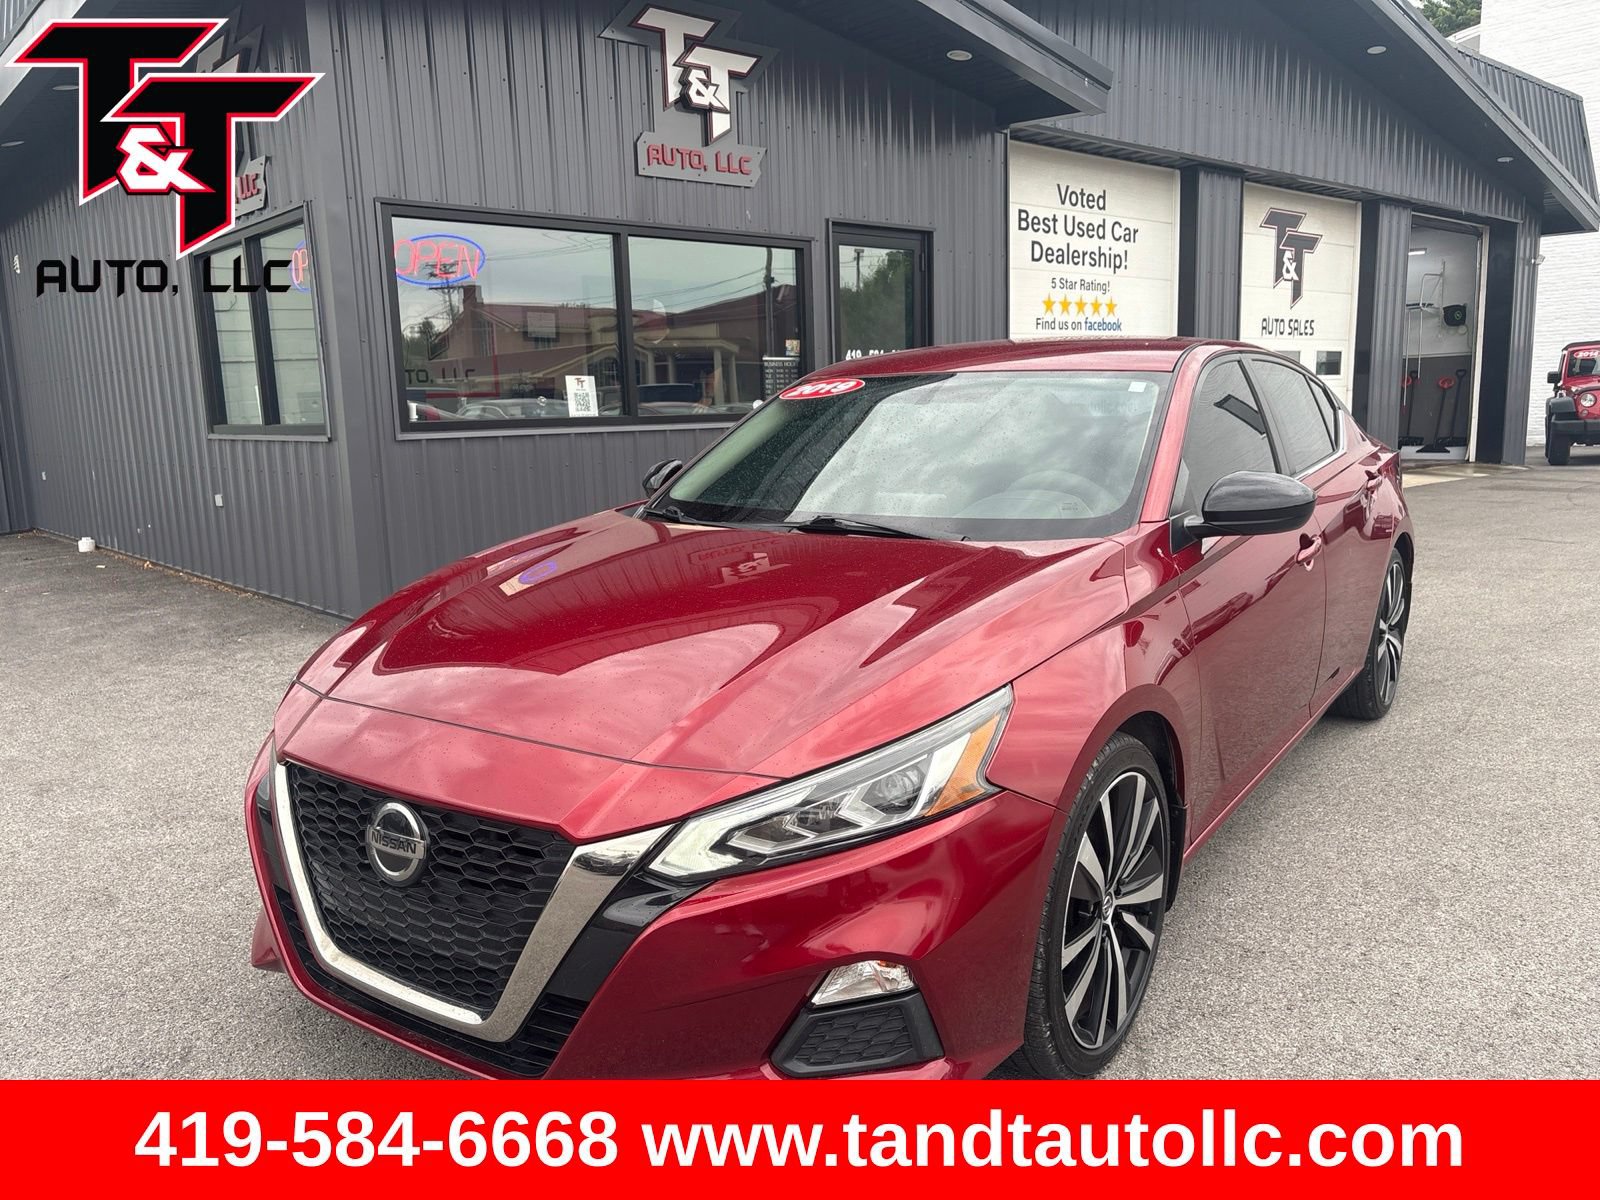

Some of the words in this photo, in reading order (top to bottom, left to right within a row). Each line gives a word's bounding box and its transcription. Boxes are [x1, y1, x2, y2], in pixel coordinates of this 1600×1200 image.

[628, 4, 761, 145] T&T
[647, 143, 708, 171] AUTO,
[715, 151, 752, 175] LLC
[238, 172, 260, 200] LLC
[1056, 183, 1107, 211] Voted
[1018, 208, 1058, 235] Best
[1064, 214, 1107, 240] Used
[1111, 221, 1139, 243] Car
[394, 239, 480, 280] OPEN
[1031, 240, 1128, 274] Dealership!
[1259, 207, 1323, 310] T&T
[1051, 277, 1057, 289] 5
[1059, 277, 1077, 290] Star
[1080, 279, 1110, 295] Rating!
[1035, 317, 1056, 330] Find
[1058, 320, 1069, 330] us
[1071, 320, 1082, 330] on
[1084, 317, 1122, 331] facebook
[1261, 316, 1286, 337] AUTO
[1288, 319, 1315, 338] SALES
[785, 380, 858, 397] 2019
[371, 831, 417, 855] NISSAN
